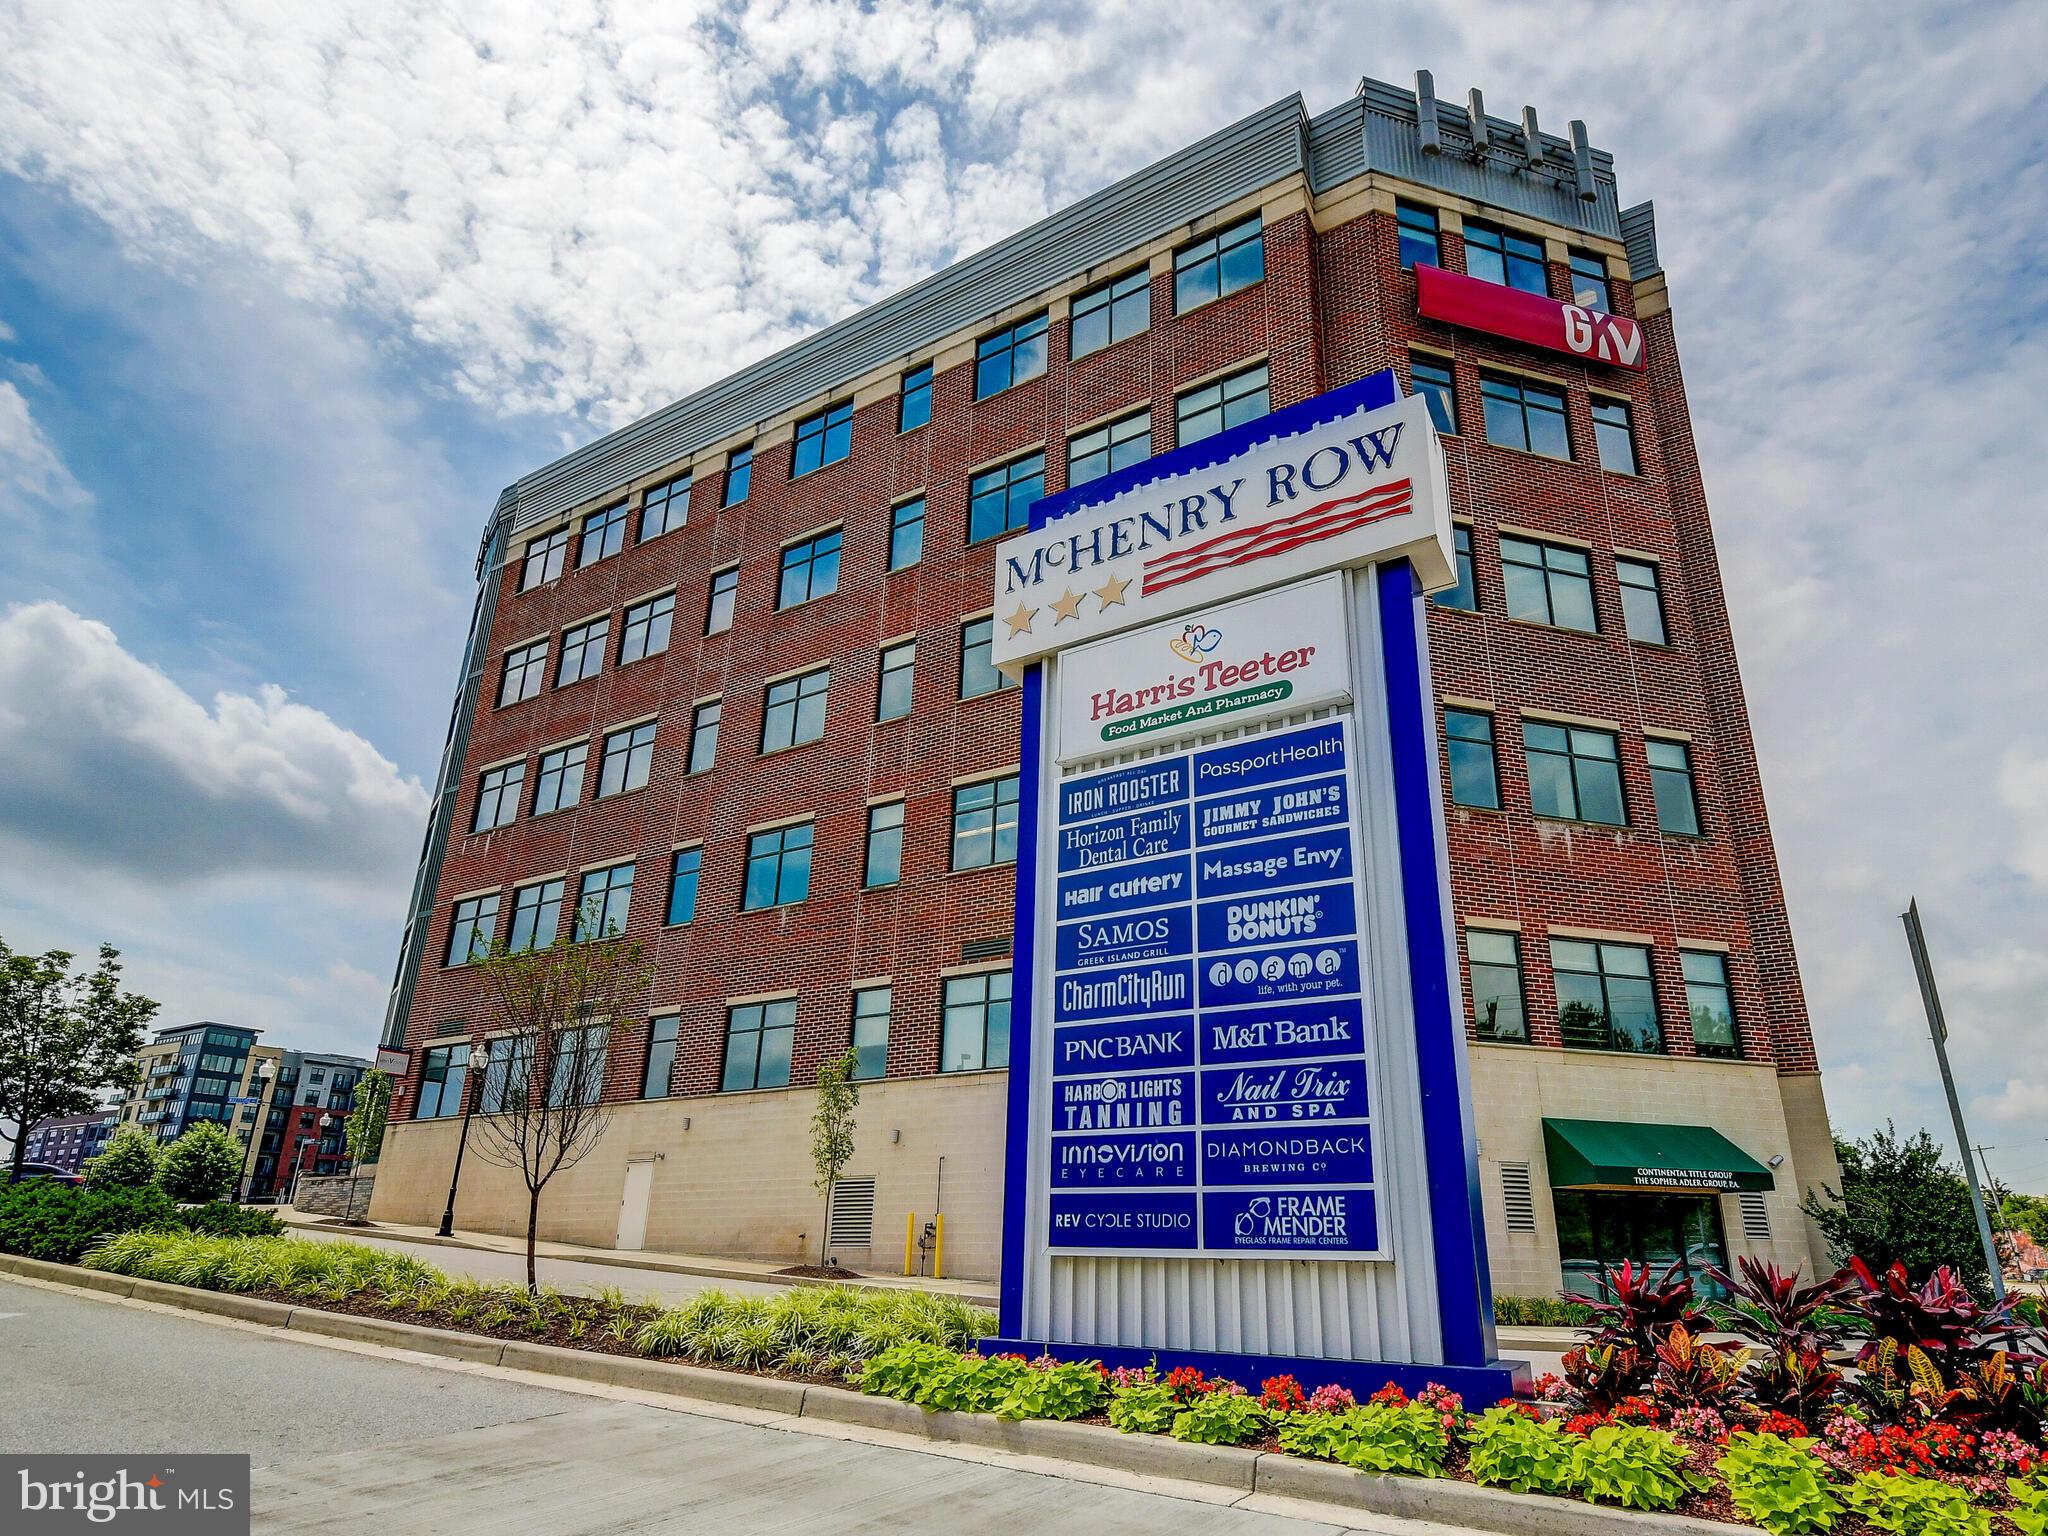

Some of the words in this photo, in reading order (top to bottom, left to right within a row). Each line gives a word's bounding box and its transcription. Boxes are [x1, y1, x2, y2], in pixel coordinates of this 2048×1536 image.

[1562, 304, 1642, 365] GKV
[1266, 421, 1406, 508] ROW
[1090, 675, 1195, 721] Harris
[1199, 646, 1316, 692] Teeter
[1108, 720, 1137, 737] Food
[1140, 711, 1183, 729] Market
[1185, 699, 1212, 718] And
[1216, 686, 1284, 711] Pharmacy
[1068, 787, 1103, 815] IRON
[1109, 769, 1180, 806] ROOSTER
[1203, 800, 1261, 827] JIMMY
[1273, 786, 1341, 815] JOHN'S
[1066, 825, 1124, 849] Horizon
[1131, 809, 1182, 836] Family
[1203, 819, 1257, 837] GOURMET
[1262, 805, 1341, 827] SANDWICHES
[1079, 840, 1127, 868] Dental
[1133, 838, 1169, 857] Care
[1204, 856, 1288, 881] Massage
[1294, 847, 1342, 868] Envy
[1065, 885, 1103, 906] Hair
[1227, 894, 1320, 924] DUNKIN'
[1078, 918, 1169, 949] SAMOS
[1078, 955, 1105, 967] GREEK
[1107, 951, 1141, 963] ISLAND
[1143, 947, 1169, 958] GRILL
[1210, 951, 1340, 986] dogma
[1258, 985, 1275, 995] life,
[1278, 982, 1298, 992] with
[1300, 981, 1323, 992] your
[1325, 978, 1343, 990] pet.
[1064, 1037, 1113, 1061] PNC
[1115, 1031, 1183, 1057] BANK
[1213, 1022, 1271, 1050] M&T
[1274, 1016, 1351, 1045] Bank
[1065, 1079, 1127, 1104] HARBOR
[1131, 1078, 1182, 1099] LIGHTS
[1217, 1070, 1286, 1103] Nail
[1291, 1067, 1350, 1099] Trix
[1065, 1100, 1182, 1129] TANNING
[1232, 1105, 1277, 1120] AND
[1292, 1103, 1336, 1117] SPA
[1208, 1137, 1365, 1158] DIAMONDBACK
[1061, 1166, 1184, 1178] EYECARE
[1244, 1163, 1305, 1173] BREWING
[1633, 1177, 1649, 1185] THE
[1650, 1177, 1678, 1186] SOPHER
[1679, 1178, 1702, 1187] ADLER
[1702, 1179, 1728, 1188] GROUP,
[1637, 1168, 1688, 1178] CONTINENTAL
[1688, 1170, 1708, 1178] TITLE
[1708, 1171, 1733, 1179] GROUP
[1056, 1214, 1081, 1227] REV
[1085, 1213, 1131, 1228] CYCLE
[1137, 1213, 1190, 1228] STUDIO
[1277, 1196, 1346, 1216] FRAME
[1235, 1236, 1266, 1244] EYEGLASS
[1268, 1236, 1292, 1244] FRAME
[1293, 1236, 1316, 1244] REPAIR
[1318, 1236, 1348, 1244] CENTERS
[1264, 1216, 1347, 1236] MENDER
